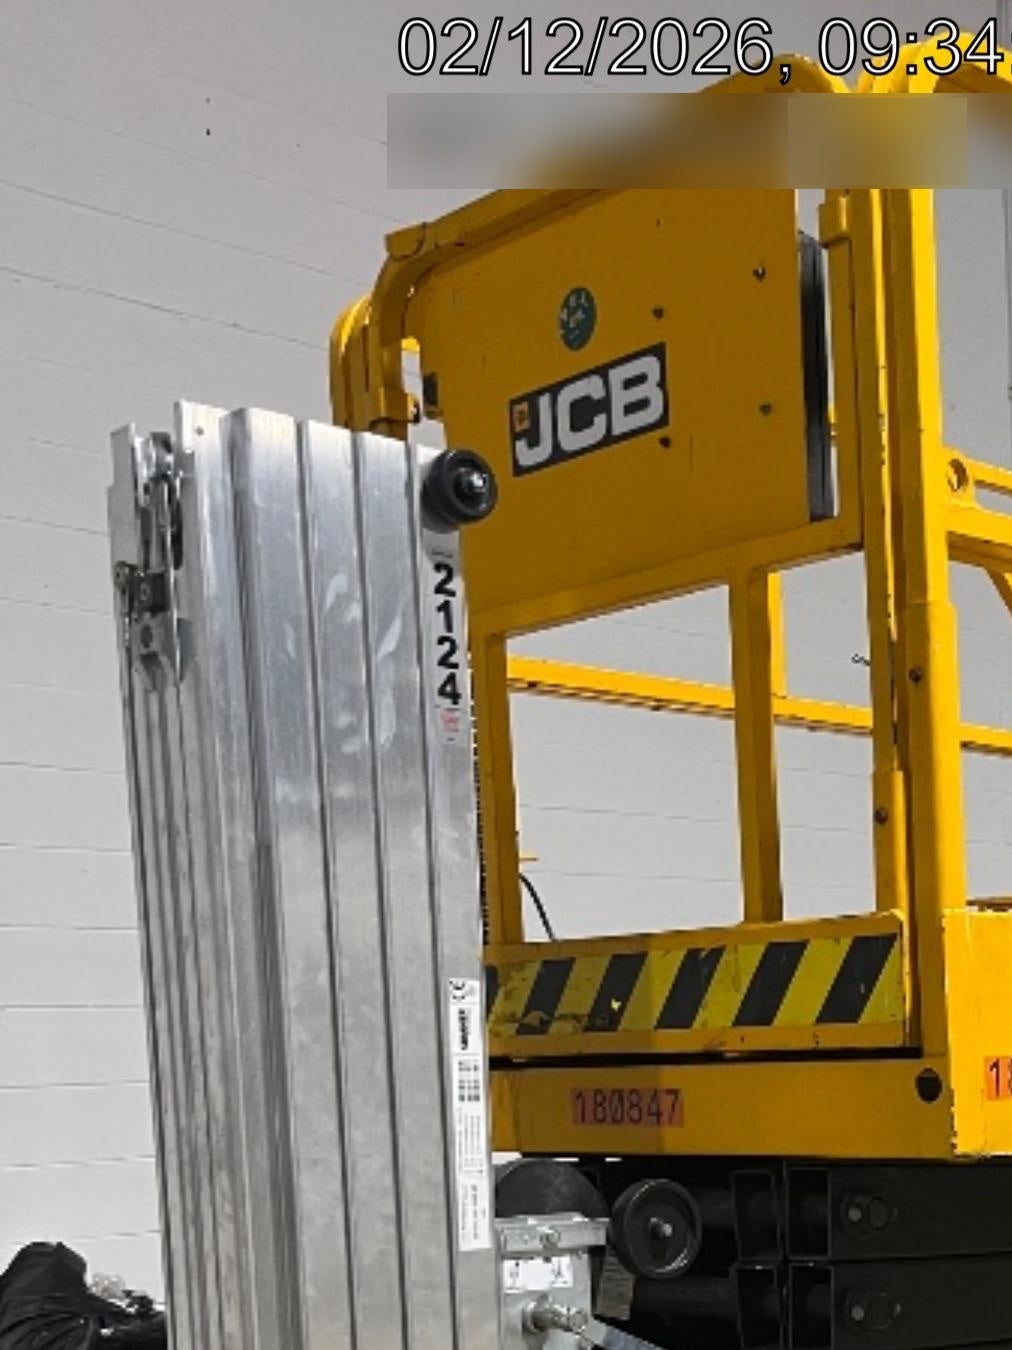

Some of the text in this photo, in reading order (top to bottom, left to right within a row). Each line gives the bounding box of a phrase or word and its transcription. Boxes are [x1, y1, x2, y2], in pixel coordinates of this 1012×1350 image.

[514, 355, 665, 468] JCB
[433, 562, 462, 705] 2124
[575, 1087, 680, 1126] 180847
